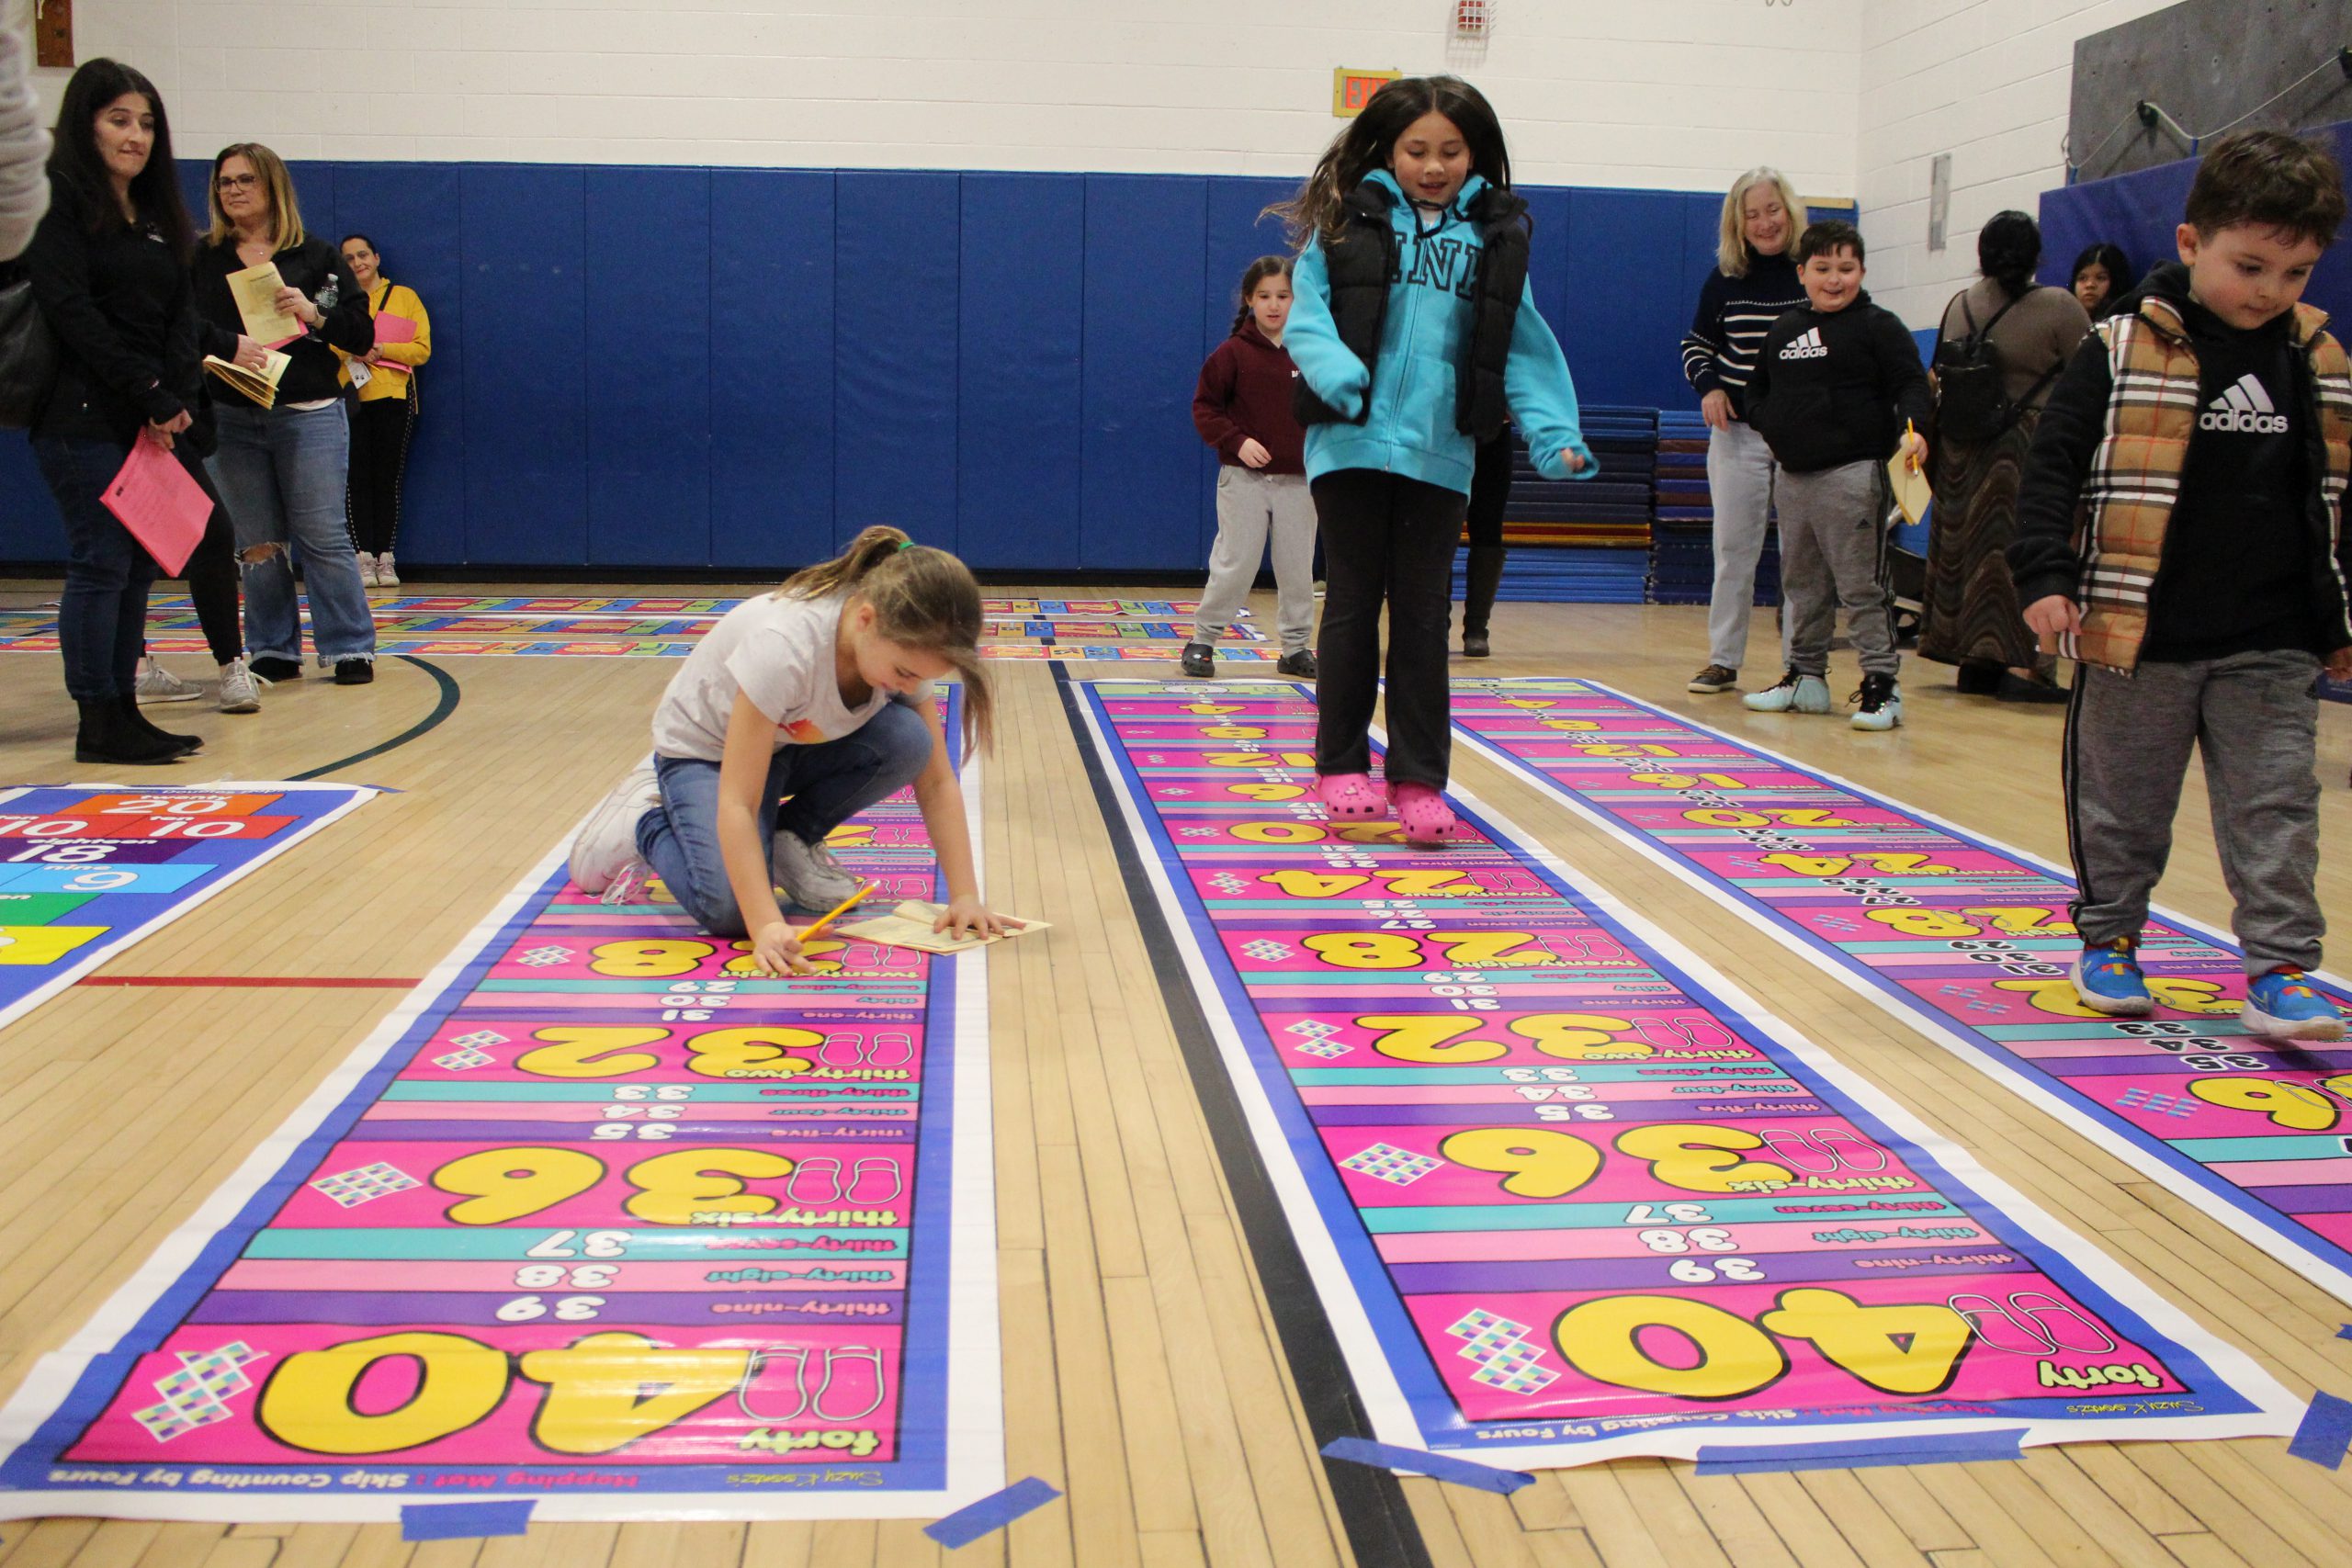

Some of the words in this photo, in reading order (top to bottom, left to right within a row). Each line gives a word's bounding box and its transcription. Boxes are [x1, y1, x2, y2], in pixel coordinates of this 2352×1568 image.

[1779, 346, 1828, 359] adidas
[2199, 409, 2289, 434] adidas
[1198, 727, 1269, 739] 8
[1537, 719, 1604, 731] 8
[1568, 743, 1684, 758] 12
[1627, 773, 1749, 790] 16
[99, 799, 228, 814] 20
[1698, 800, 1745, 808] 19
[1679, 807, 1855, 828] 20
[148, 820, 246, 837] 10
[27, 837, 158, 846] eighteen
[1745, 835, 1799, 843] 22
[6, 844, 118, 863] 18
[1756, 843, 1816, 852] 23
[1328, 860, 1380, 869] 23
[1757, 852, 1960, 877] 24
[61, 871, 140, 891] 9
[1256, 870, 1485, 897] 24
[1818, 877, 1883, 886] 25
[1402, 889, 1555, 898] twenty-four
[1839, 886, 1904, 896] 26
[1360, 899, 1419, 908] 25
[1861, 895, 1922, 906] 27
[1368, 909, 1428, 919] 26
[1380, 919, 1438, 930] 27
[1863, 908, 2078, 938] 28
[1299, 931, 1559, 969] 28
[1947, 940, 2017, 953] 29
[1451, 957, 1639, 969] twenty-eight
[1968, 953, 2041, 964] 30
[1998, 963, 2064, 976] 31
[1421, 972, 1487, 984] 29
[668, 981, 738, 992] 29
[1430, 984, 1497, 996] 30
[660, 994, 733, 1008] 30
[1451, 998, 1504, 1010] 31
[1580, 998, 1689, 1010] thirty-one
[660, 1009, 716, 1021] 31
[800, 1011, 916, 1021] thirty-one
[2112, 1021, 2197, 1037] 33
[1352, 1013, 1655, 1064] 32
[2146, 1037, 2232, 1053] 34
[512, 1027, 827, 1080] 32
[1581, 1049, 1756, 1064] thirty-two
[2181, 1054, 2270, 1071] 35
[725, 1066, 912, 1081] thirty-two
[1501, 1066, 1580, 1082] 33
[613, 1085, 695, 1101] 33
[760, 1087, 910, 1098] thirty-three
[1512, 1085, 1599, 1102] 34
[1671, 1083, 1798, 1095] thirty-four
[601, 1104, 687, 1120] 34
[768, 1107, 909, 1116] thirty-four
[1534, 1103, 1616, 1121] 35
[1696, 1102, 1820, 1115] thirty-five
[589, 1122, 678, 1141] 35
[769, 1126, 905, 1138] thirty-five
[1436, 1123, 1793, 1198] 36
[428, 1146, 796, 1227] 36
[1725, 1174, 1916, 1195] thirty-six
[1623, 1203, 1714, 1225] 37
[1773, 1200, 1947, 1214] thirty-seven
[691, 1207, 899, 1228] thirty-six
[1637, 1227, 1740, 1253] 38
[1812, 1226, 1980, 1243] thirty-eight
[524, 1230, 633, 1258] 37
[1852, 1252, 2016, 1269] thirty-nine
[514, 1265, 622, 1289] 38
[704, 1267, 896, 1284] thirty-eight
[1668, 1257, 1767, 1282] 39
[495, 1295, 607, 1322] 39
[708, 1300, 892, 1317] thirty-nine
[1550, 1286, 1982, 1404] 40
[2035, 1359, 2162, 1391] forty
[253, 1330, 766, 1457] 40
[1475, 1427, 1557, 1440] Fours
[1562, 1423, 1597, 1438] by
[738, 1427, 881, 1456] forty
[48, 1471, 139, 1485] Fours
[141, 1468, 184, 1487] by
[188, 1469, 333, 1488] Counting
[339, 1470, 410, 1489] Skip
